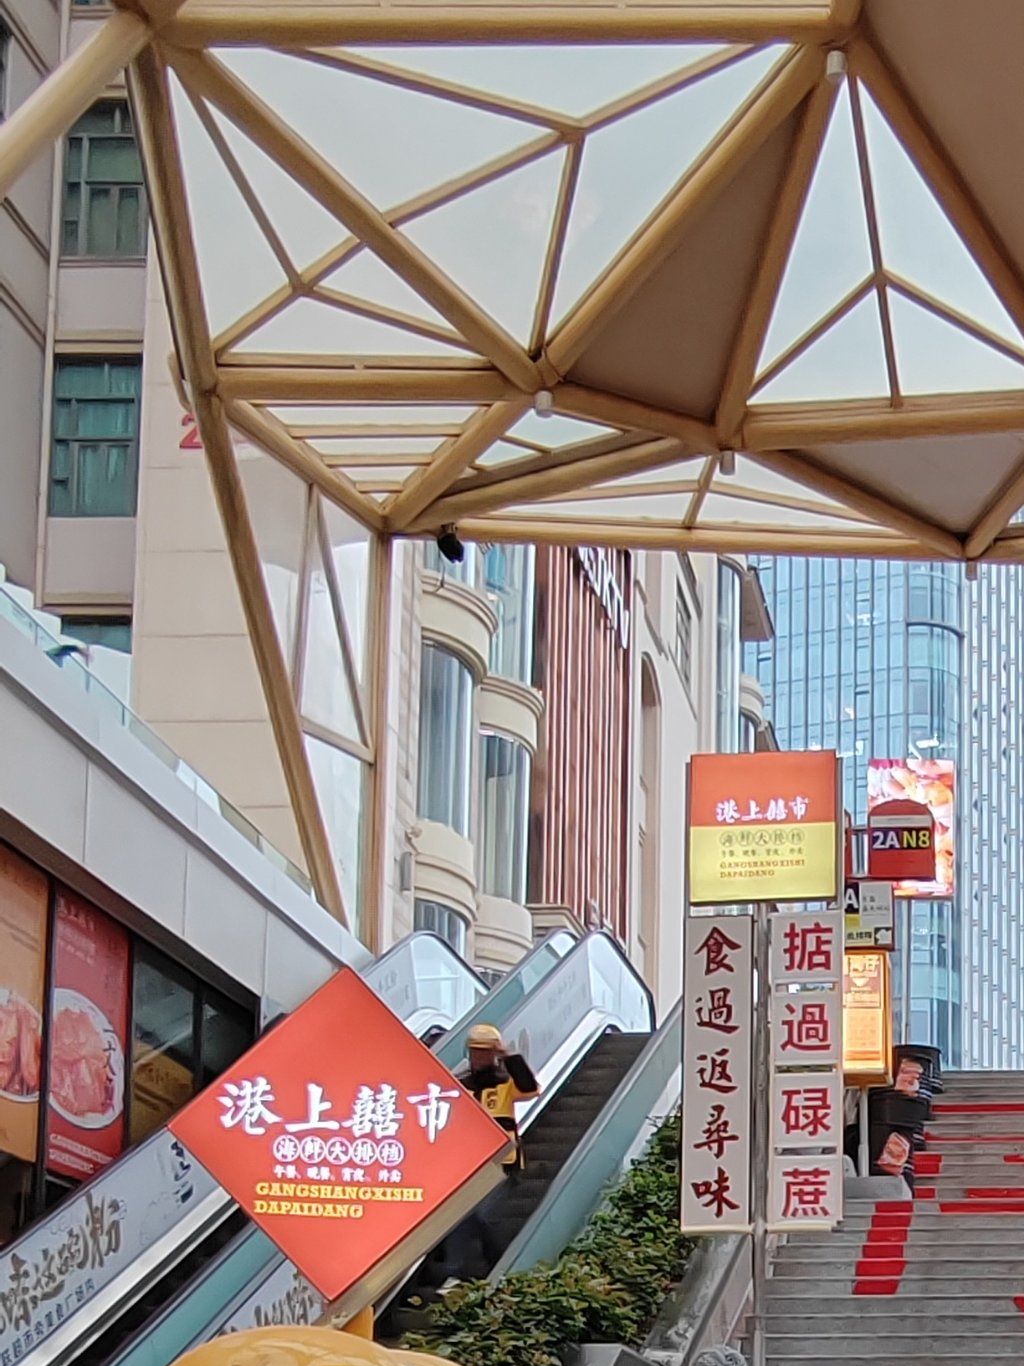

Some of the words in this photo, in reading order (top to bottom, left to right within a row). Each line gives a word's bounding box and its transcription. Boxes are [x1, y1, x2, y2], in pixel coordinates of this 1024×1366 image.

[690, 926, 743, 1219] 食過返尋味
[780, 921, 833, 1218] 掂過碌蔗
[216, 1076, 460, 1143] 港上囍市
[253, 1200, 364, 1218] DAPAIDANG
[256, 1182, 424, 1202] GANGSHANGXISHI
